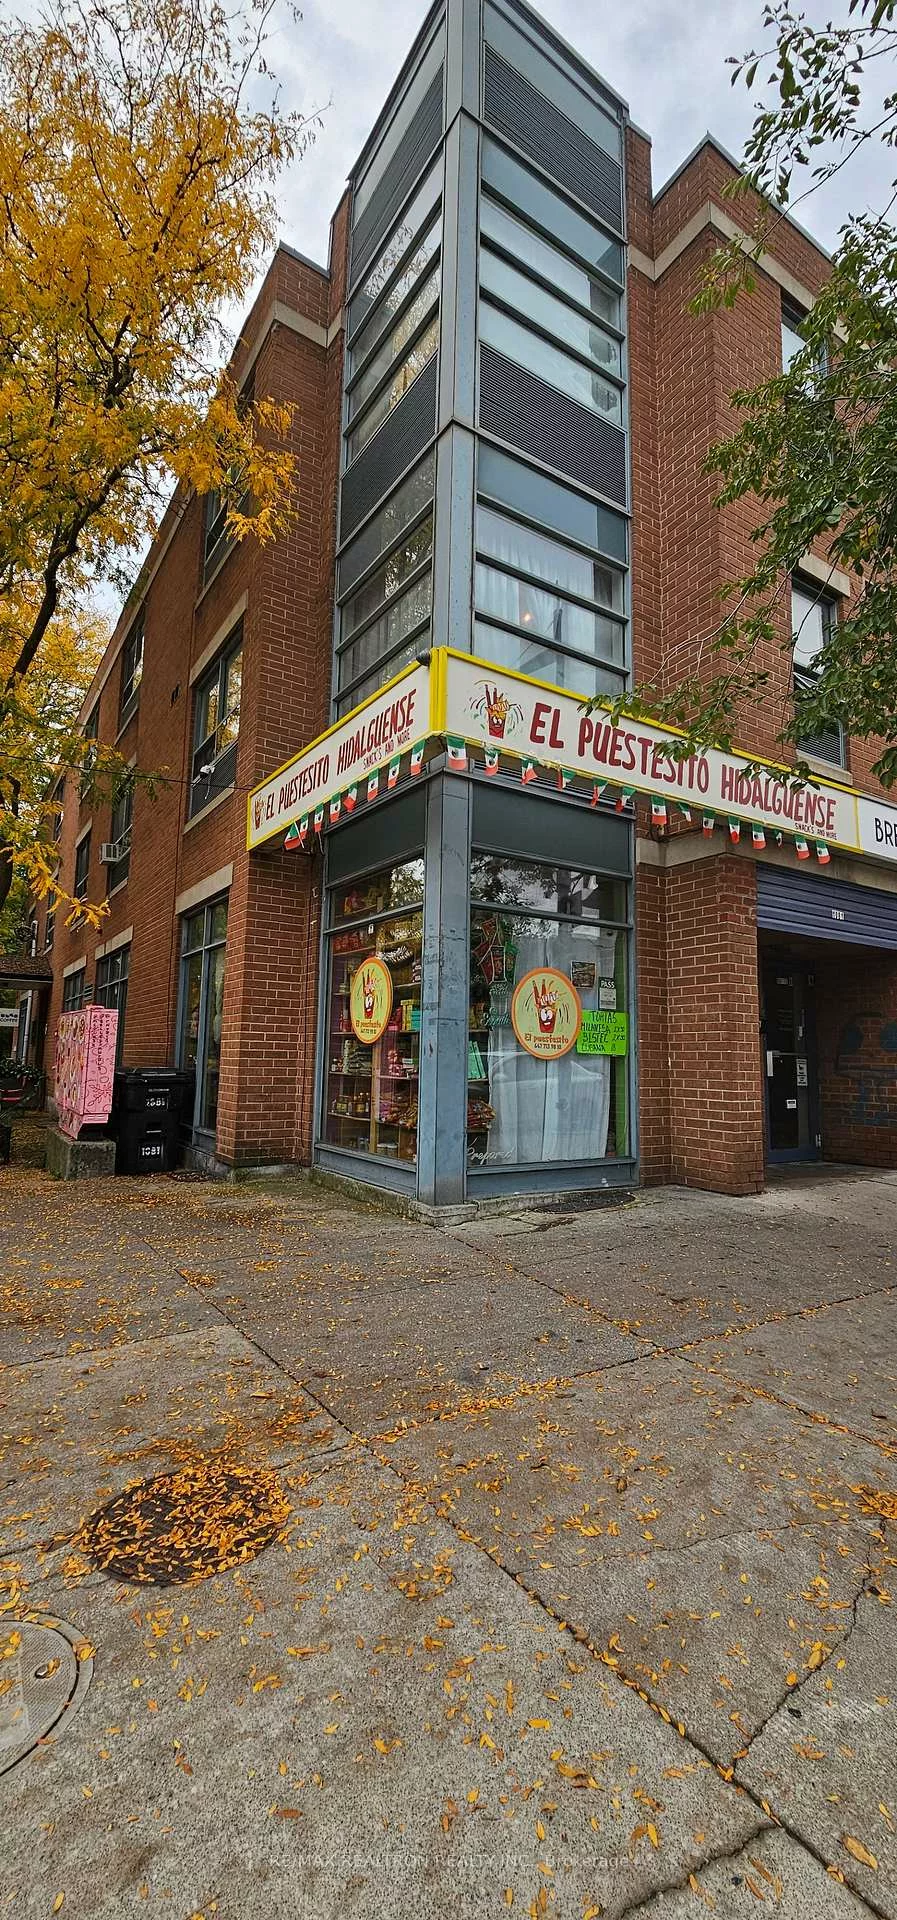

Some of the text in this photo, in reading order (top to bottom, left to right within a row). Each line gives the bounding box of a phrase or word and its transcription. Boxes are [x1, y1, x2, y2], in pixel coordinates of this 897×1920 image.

[266, 688, 417, 821] EL PUESTESITO HIDALGUENSE
[385, 739, 394, 755] AND
[530, 702, 837, 830] EL PUESTESITO HIDALGUENSE
[600, 980, 615, 989] PASS
[524, 1033, 532, 1041] El
